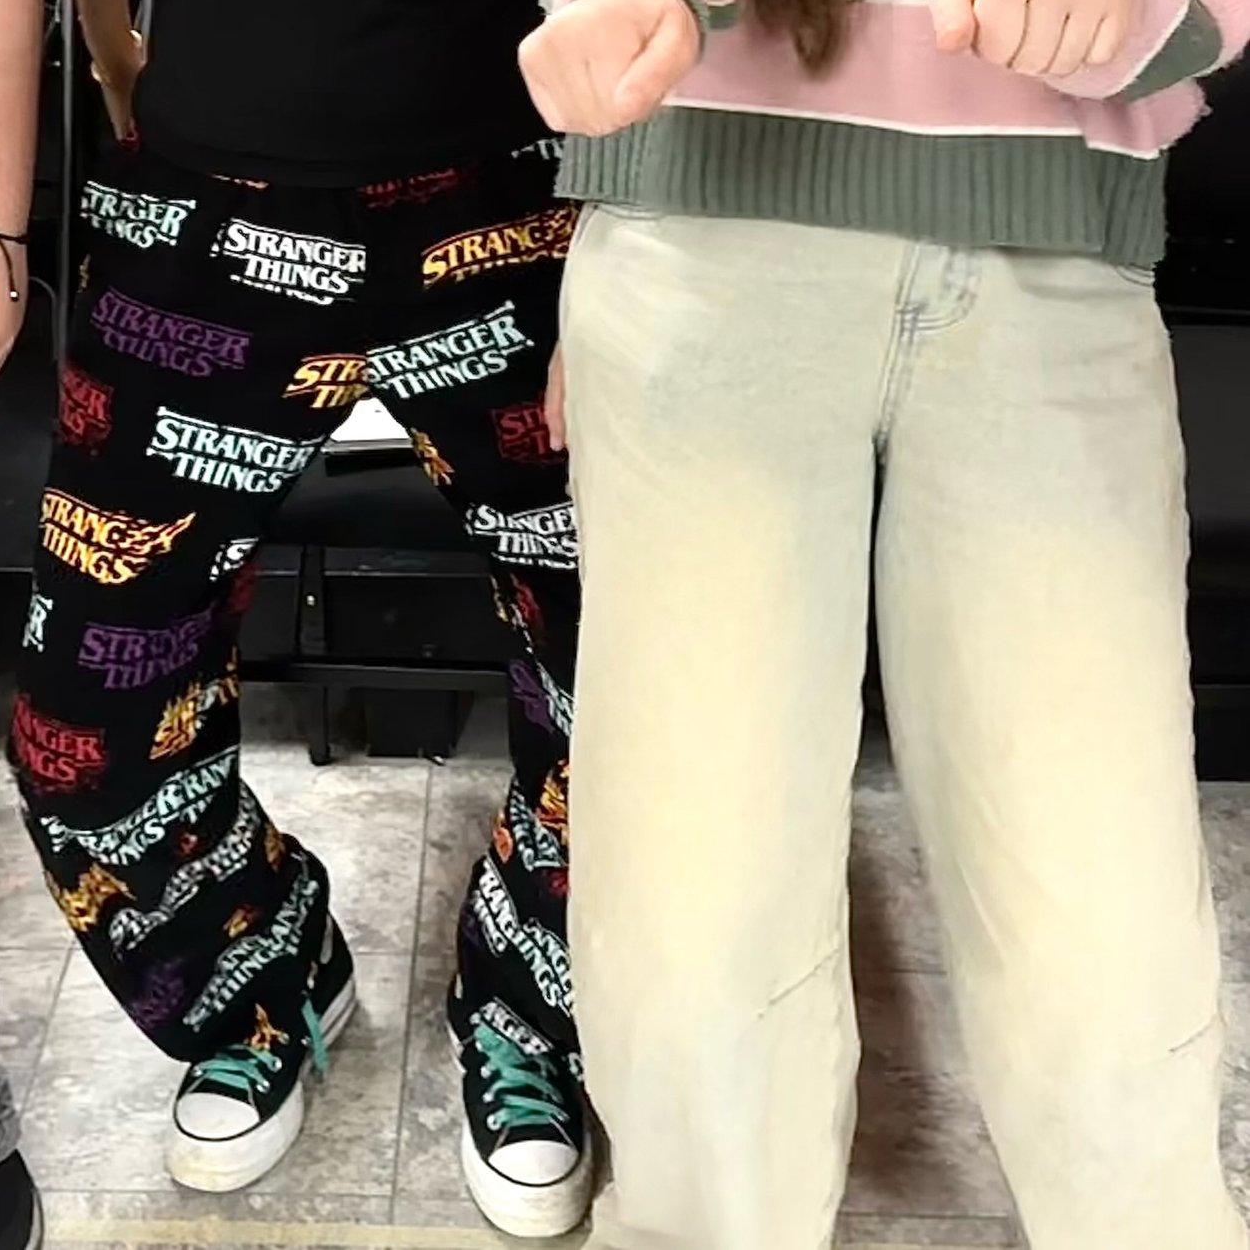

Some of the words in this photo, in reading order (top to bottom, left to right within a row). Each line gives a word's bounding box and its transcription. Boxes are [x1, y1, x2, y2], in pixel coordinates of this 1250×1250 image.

[224, 223, 366, 273] STRANGER
[245, 254, 350, 294] THINGS
[92, 291, 250, 365] STRANGER
[103, 316, 212, 376] THINGS
[387, 350, 508, 399] THINGS
[152, 418, 316, 471] STRANGER
[173, 453, 286, 493] THINGS
[43, 522, 146, 584] THINGS
